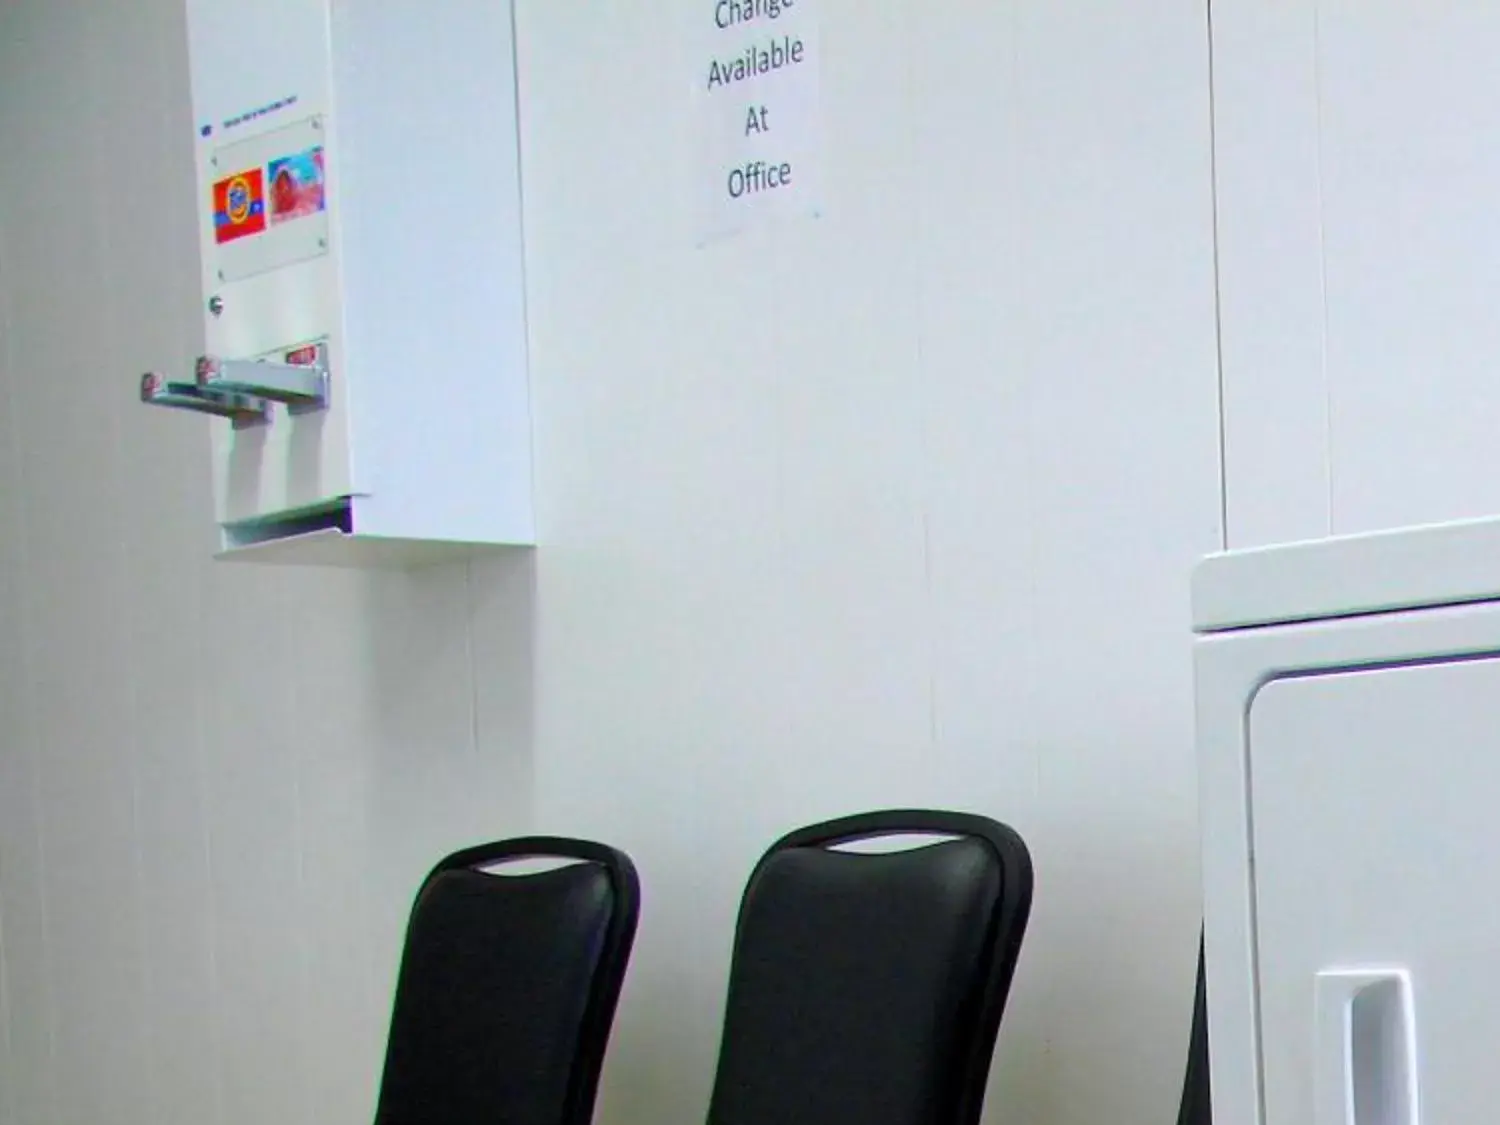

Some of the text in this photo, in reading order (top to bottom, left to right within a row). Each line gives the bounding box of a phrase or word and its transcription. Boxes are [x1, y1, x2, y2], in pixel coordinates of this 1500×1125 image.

[707, 36, 805, 90] Available
[745, 105, 769, 137] At
[727, 161, 792, 199] Office
